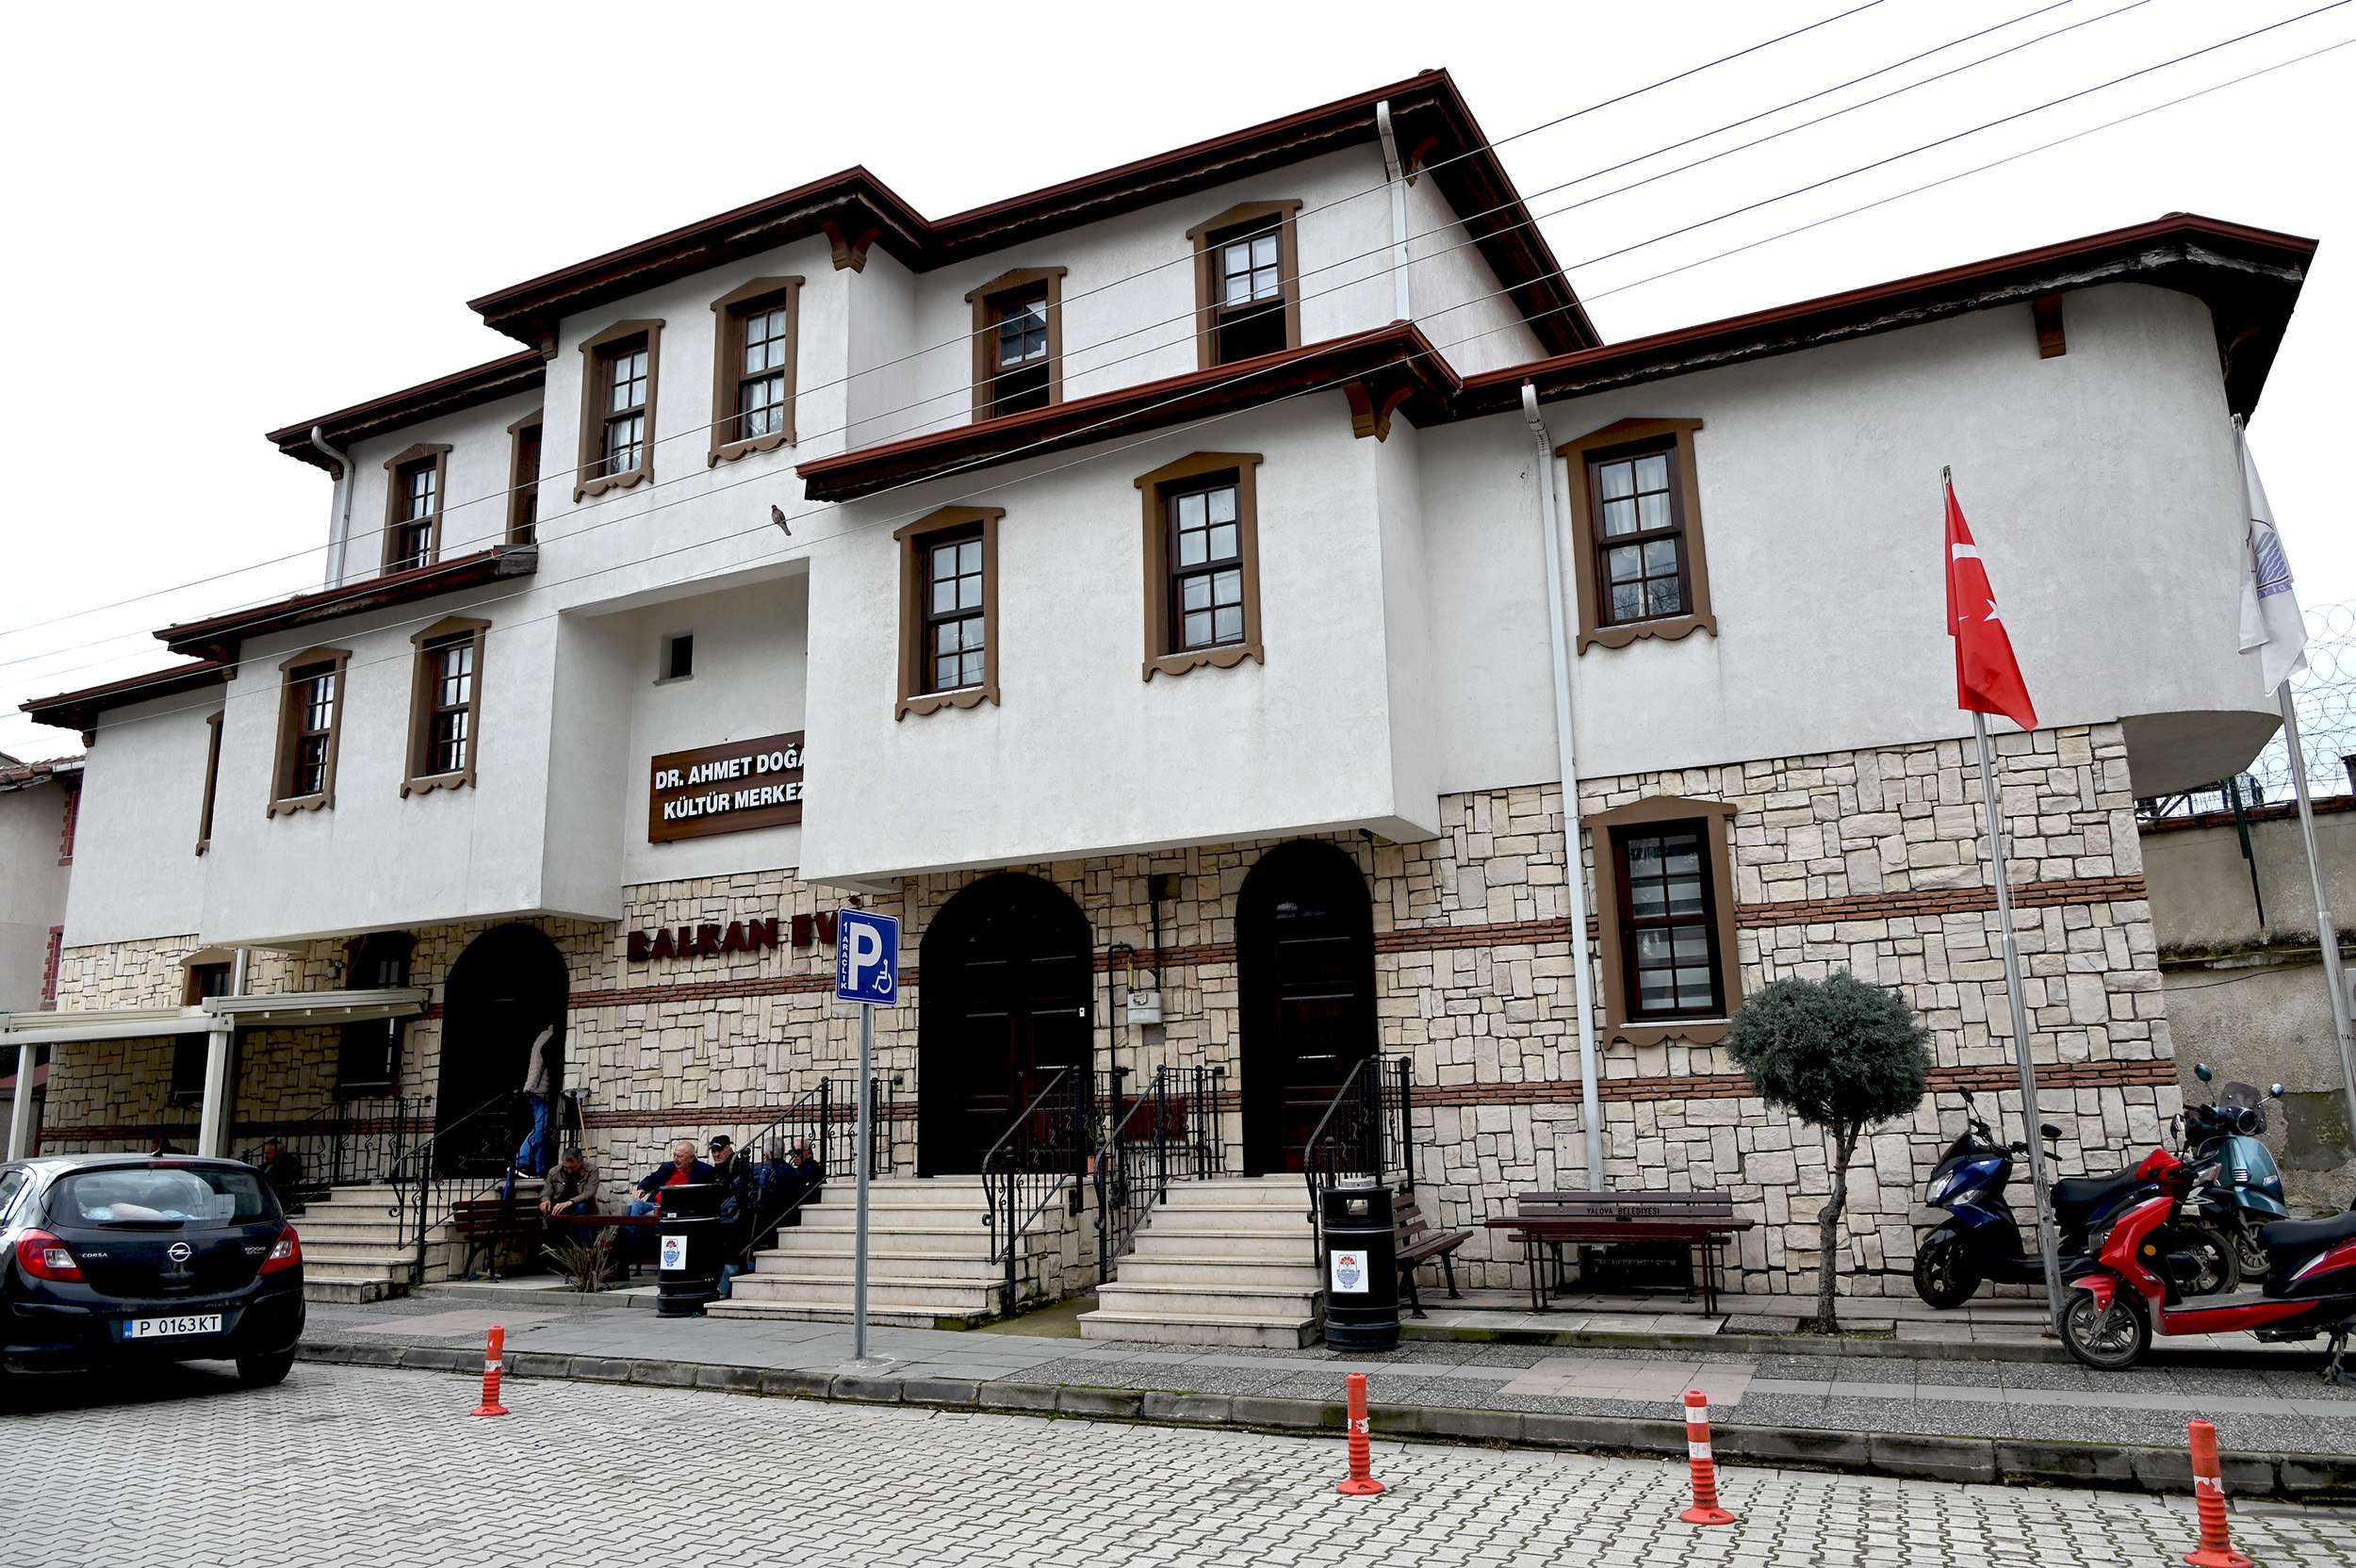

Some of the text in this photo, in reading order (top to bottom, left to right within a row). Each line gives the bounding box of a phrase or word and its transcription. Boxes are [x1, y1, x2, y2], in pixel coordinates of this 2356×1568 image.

[655, 769, 684, 791] DR.
[688, 757, 753, 785] AHMET
[663, 792, 730, 821] KÜLTÜR
[627, 917, 778, 962] BALKAN
[848, 922, 883, 990] P
[841, 936, 849, 989] ARAÇLIK
[1586, 1207, 1613, 1216] YALOVA
[139, 1320, 151, 1335] P
